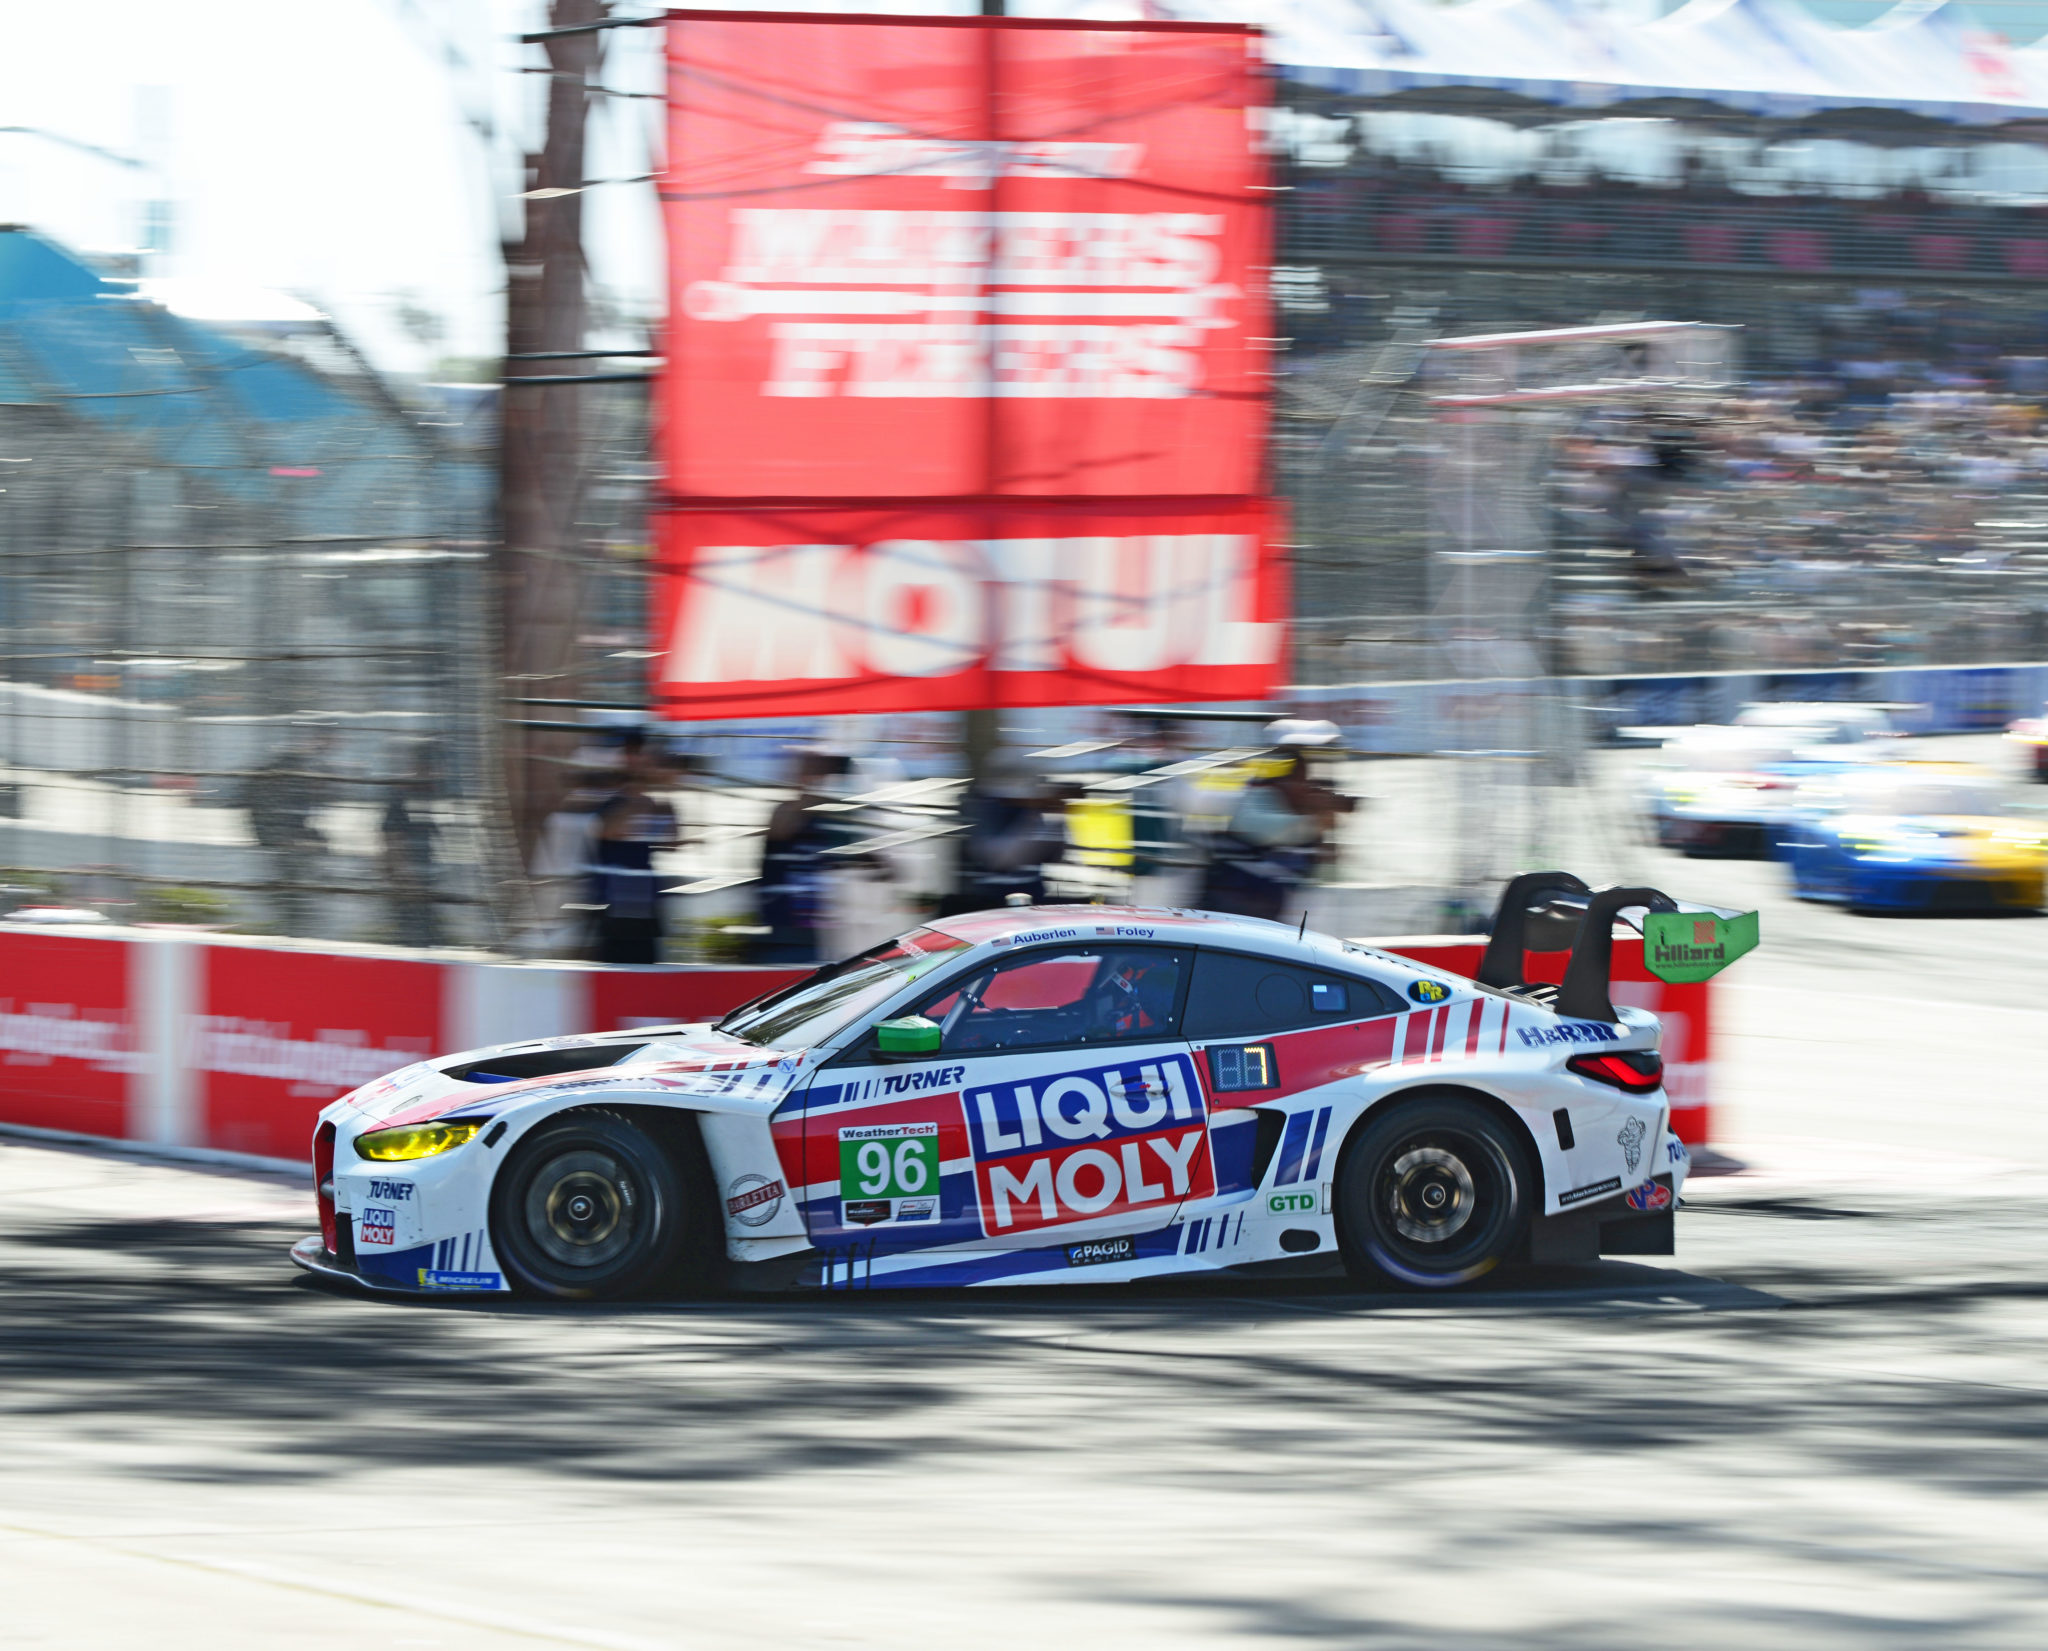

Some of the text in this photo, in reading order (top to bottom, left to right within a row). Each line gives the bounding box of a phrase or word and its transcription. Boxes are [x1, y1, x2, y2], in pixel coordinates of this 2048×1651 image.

[661, 534, 1284, 683] MOTUL
[1013, 927, 1155, 944] Auberlen Foley
[884, 1066, 966, 1095] TURNER
[976, 1060, 1193, 1153] LIQUI
[843, 1125, 935, 1138] WeatherTech
[857, 1139, 928, 1195] 96
[988, 1130, 1204, 1228] MOLY
[370, 1180, 415, 1200] TURNER
[1270, 1194, 1314, 1211] GTD
[364, 1209, 394, 1227] LIQUI
[362, 1226, 394, 1243] MOLY
[1083, 1240, 1129, 1257] PAGID
